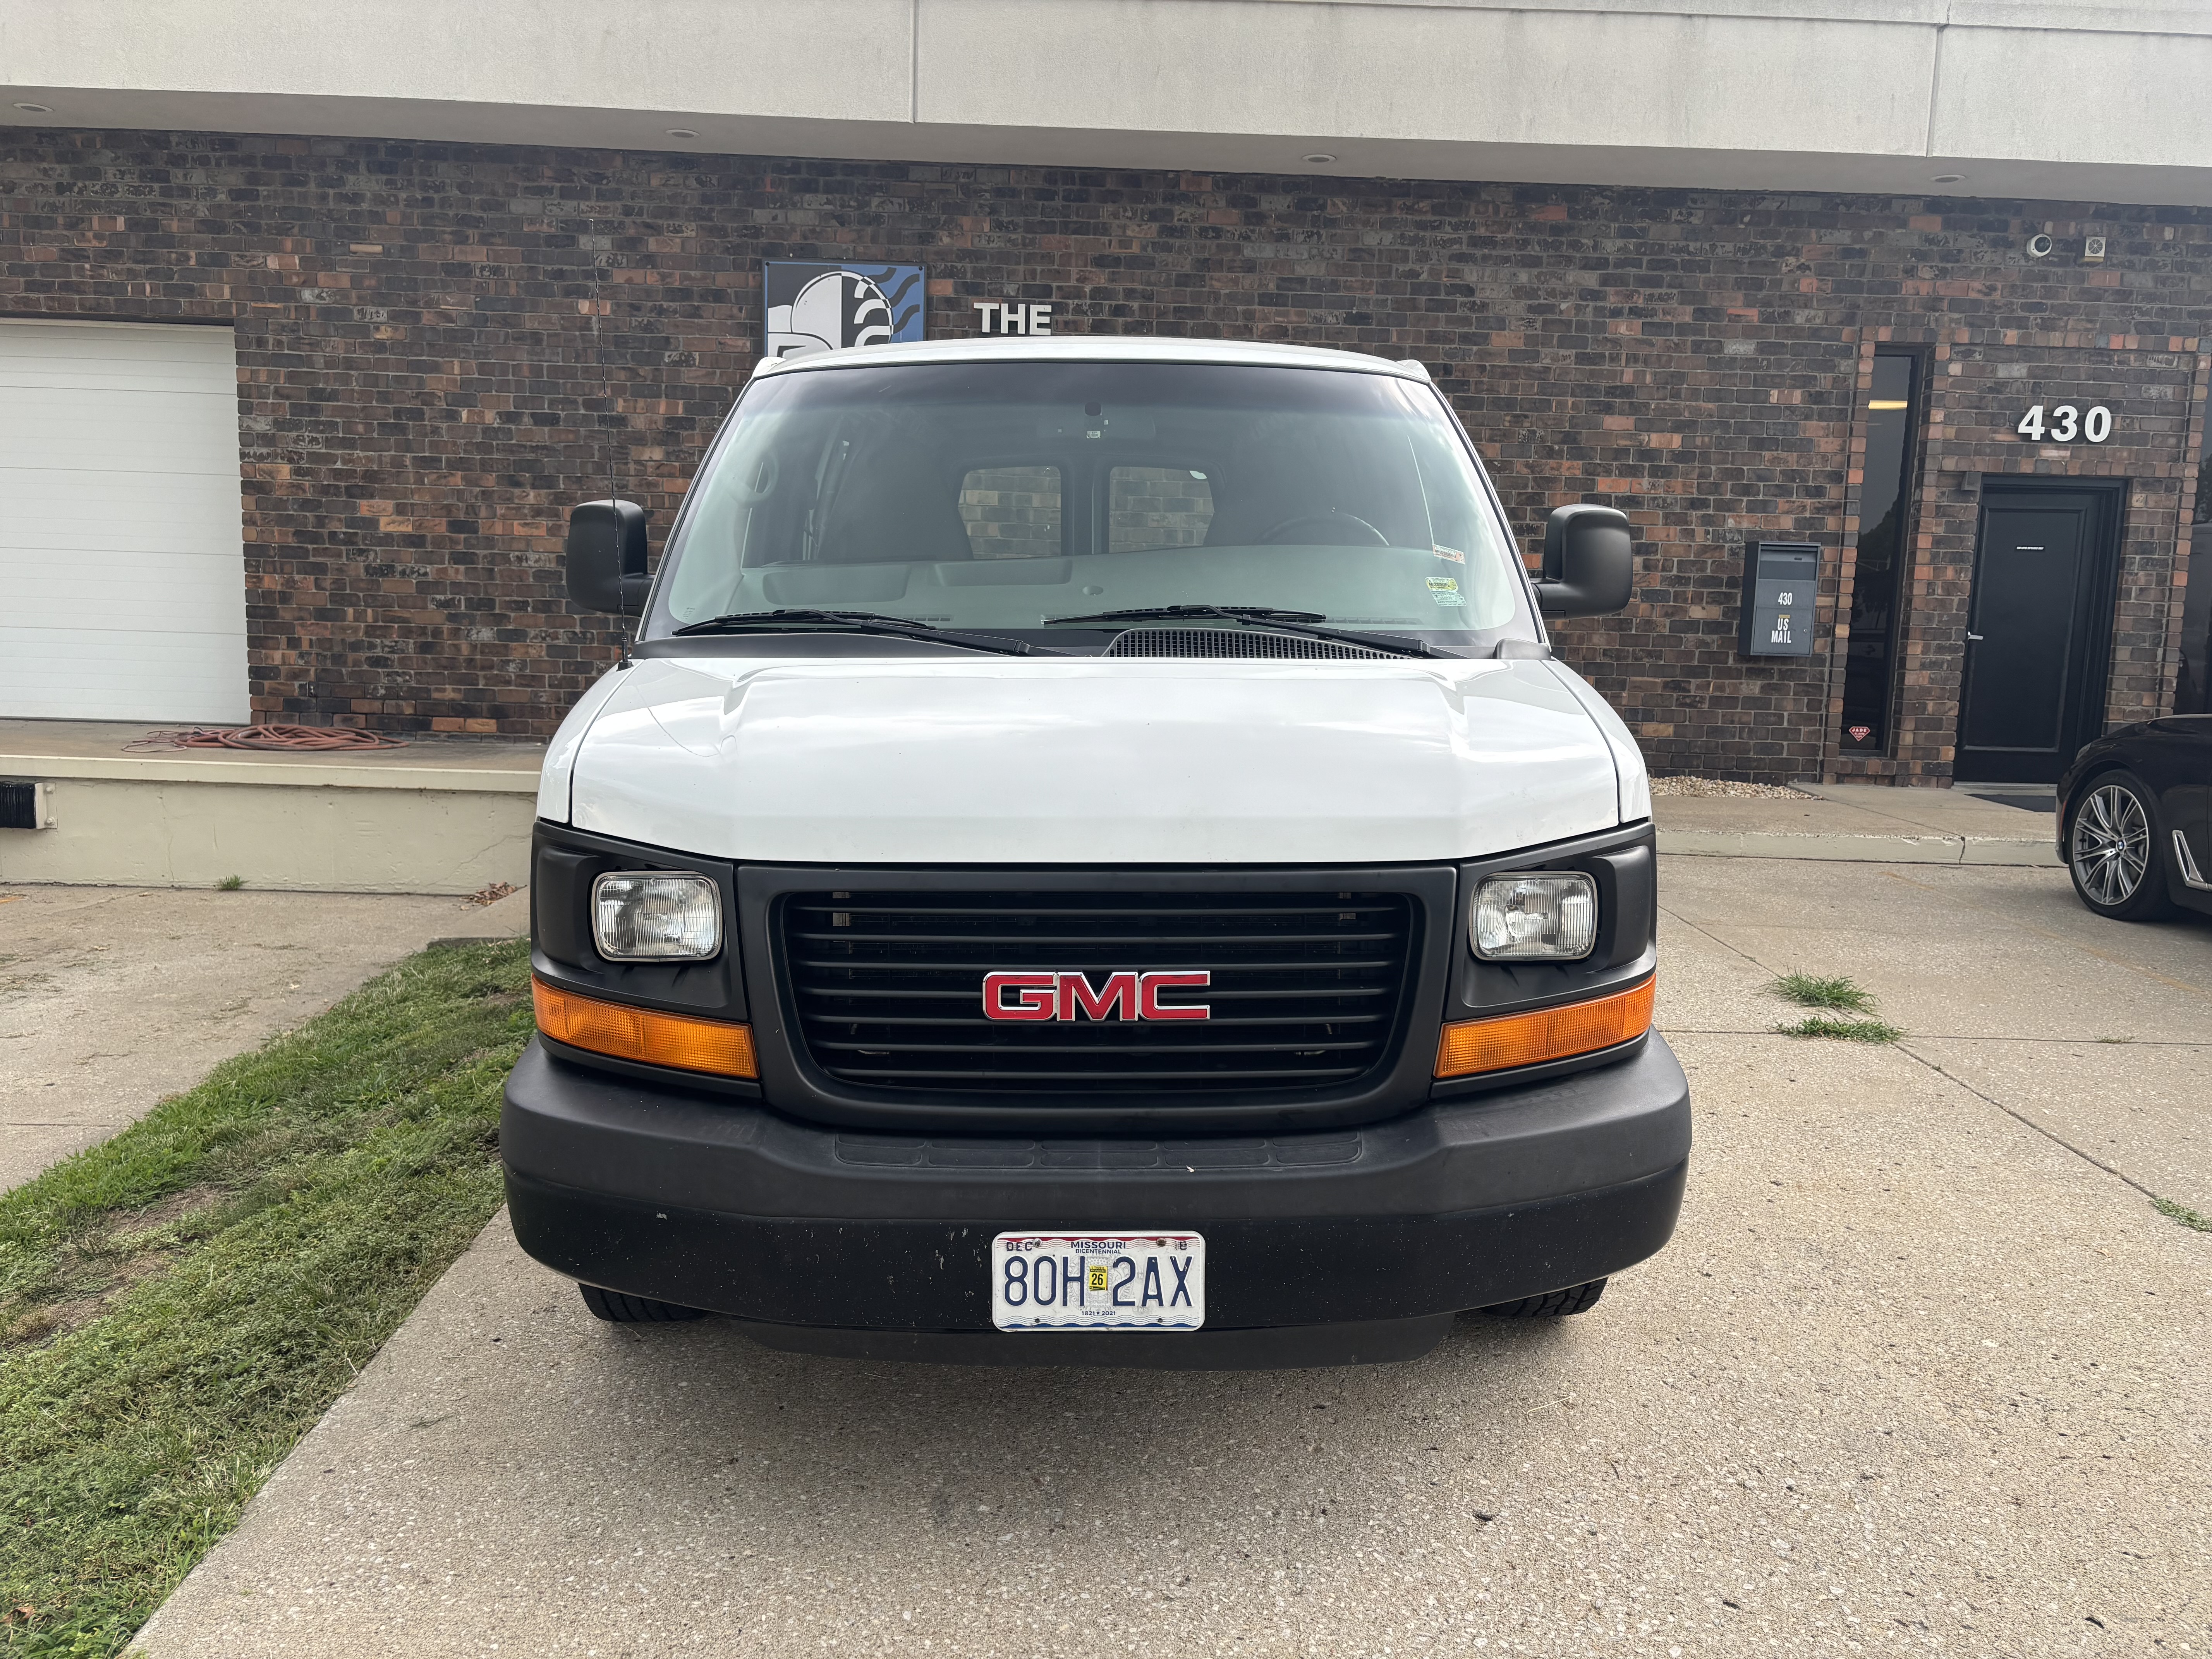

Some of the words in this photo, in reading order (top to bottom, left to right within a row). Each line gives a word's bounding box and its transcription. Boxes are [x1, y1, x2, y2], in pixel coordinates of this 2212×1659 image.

[974, 302, 1052, 336] THE
[2018, 405, 2111, 442] 430
[1778, 592, 1793, 605] 430
[1777, 618, 1789, 631] US
[1771, 630, 1791, 643] MAIL
[982, 971, 1210, 1022] GMC
[1006, 1242, 1033, 1251] DEC
[1071, 1241, 1126, 1249] MISSOURI
[1005, 1256, 1085, 1306] 80H
[1112, 1256, 1192, 1307] 2AX
[1091, 1273, 1103, 1286] 26
